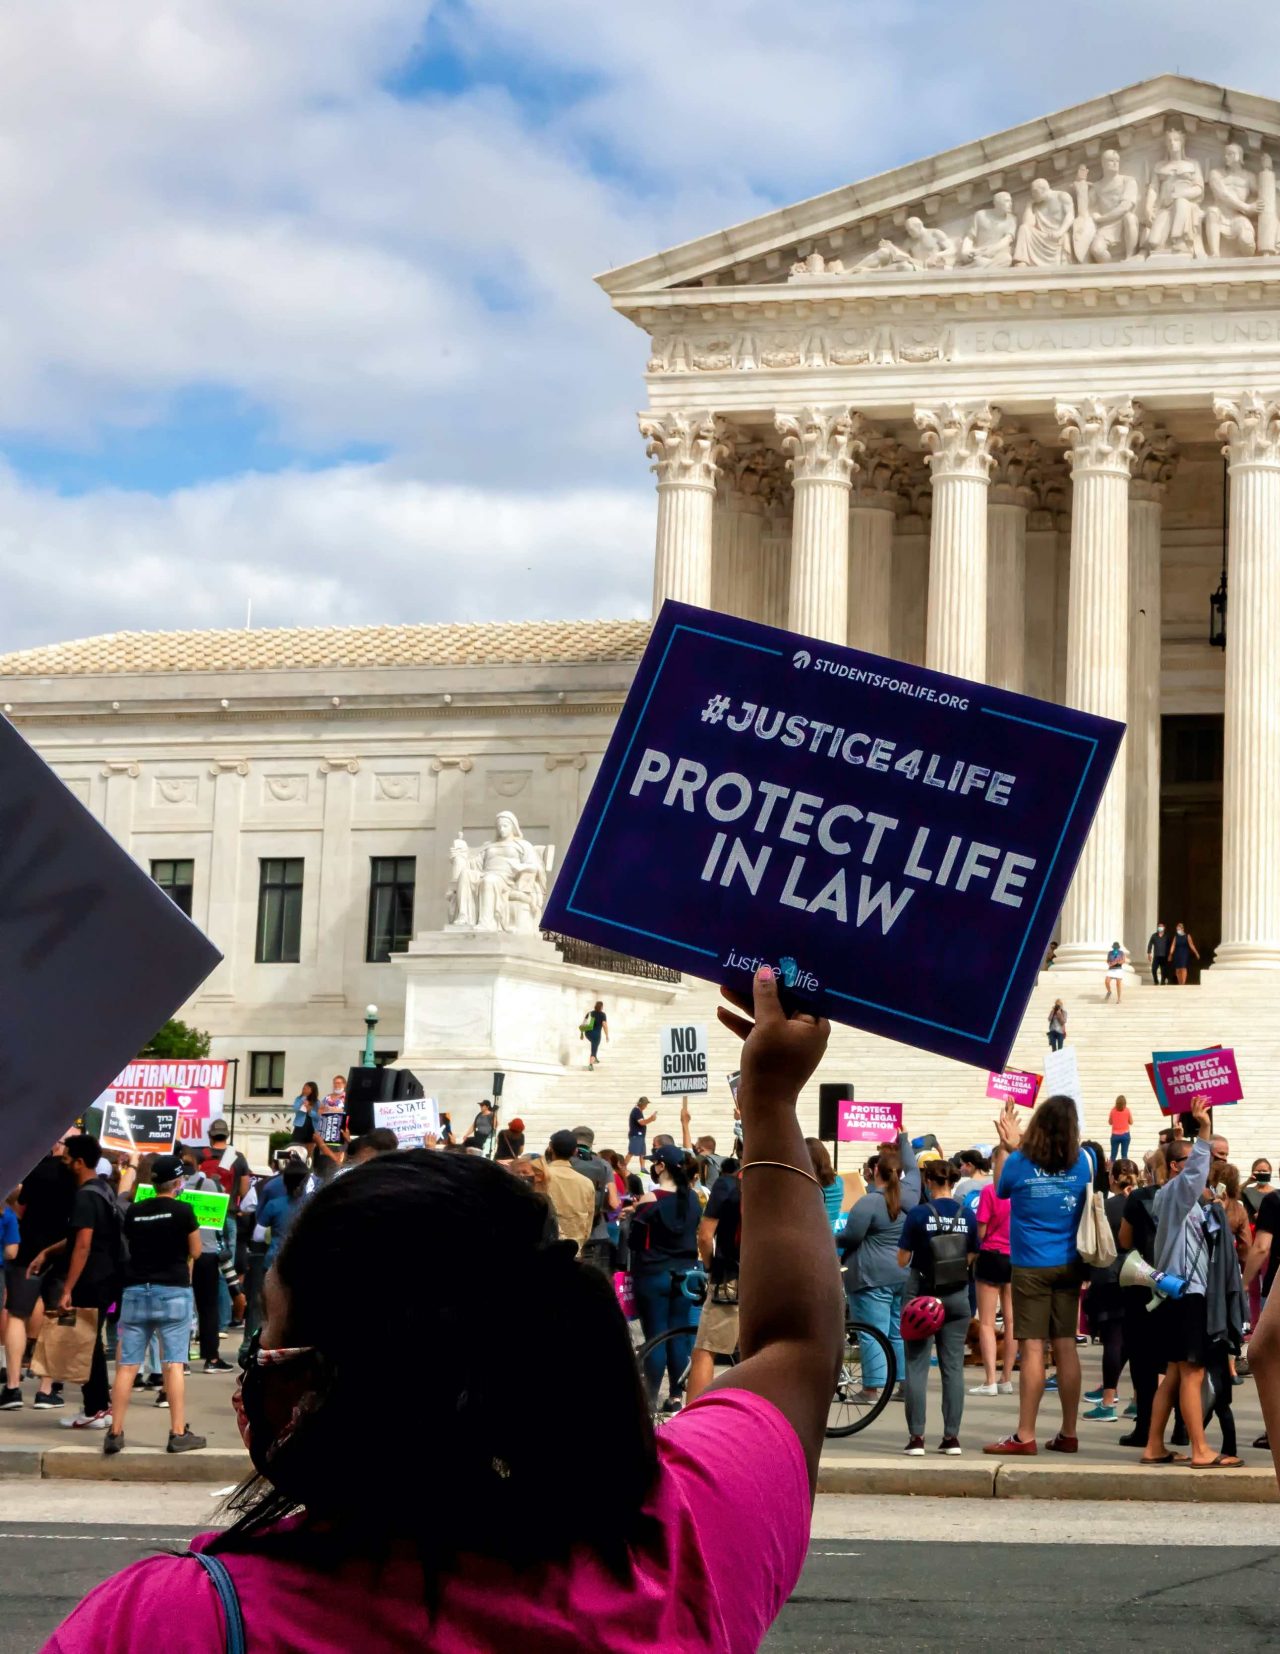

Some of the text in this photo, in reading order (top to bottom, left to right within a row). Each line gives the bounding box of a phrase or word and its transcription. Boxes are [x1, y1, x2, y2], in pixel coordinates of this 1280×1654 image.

[976, 329, 1073, 353] EQUAL
[1082, 324, 1194, 349] JUSTICE
[813, 658, 970, 711] STUDENTSFORLIFE.ORG
[700, 694, 1016, 807] #JUSTICE4LIFE
[629, 748, 1037, 908] PROTECT LIFE
[700, 832, 915, 935] IN LAW
[670, 1026, 697, 1054] NO
[663, 1052, 706, 1075] GOING
[1171, 1056, 1221, 1076] PROTECT
[662, 1076, 708, 1092] BACKWARDS
[1011, 1080, 1032, 1089] LEGAL
[1166, 1065, 1232, 1087] SAFE, LEGAL
[1173, 1075, 1230, 1096] ABORTION
[993, 1083, 1029, 1095] ABORTION
[396, 1100, 427, 1114] STATE
[850, 1105, 892, 1114] PROTECT
[870, 1113, 898, 1122] LEGAL
[846, 1120, 894, 1130] ABORTION
